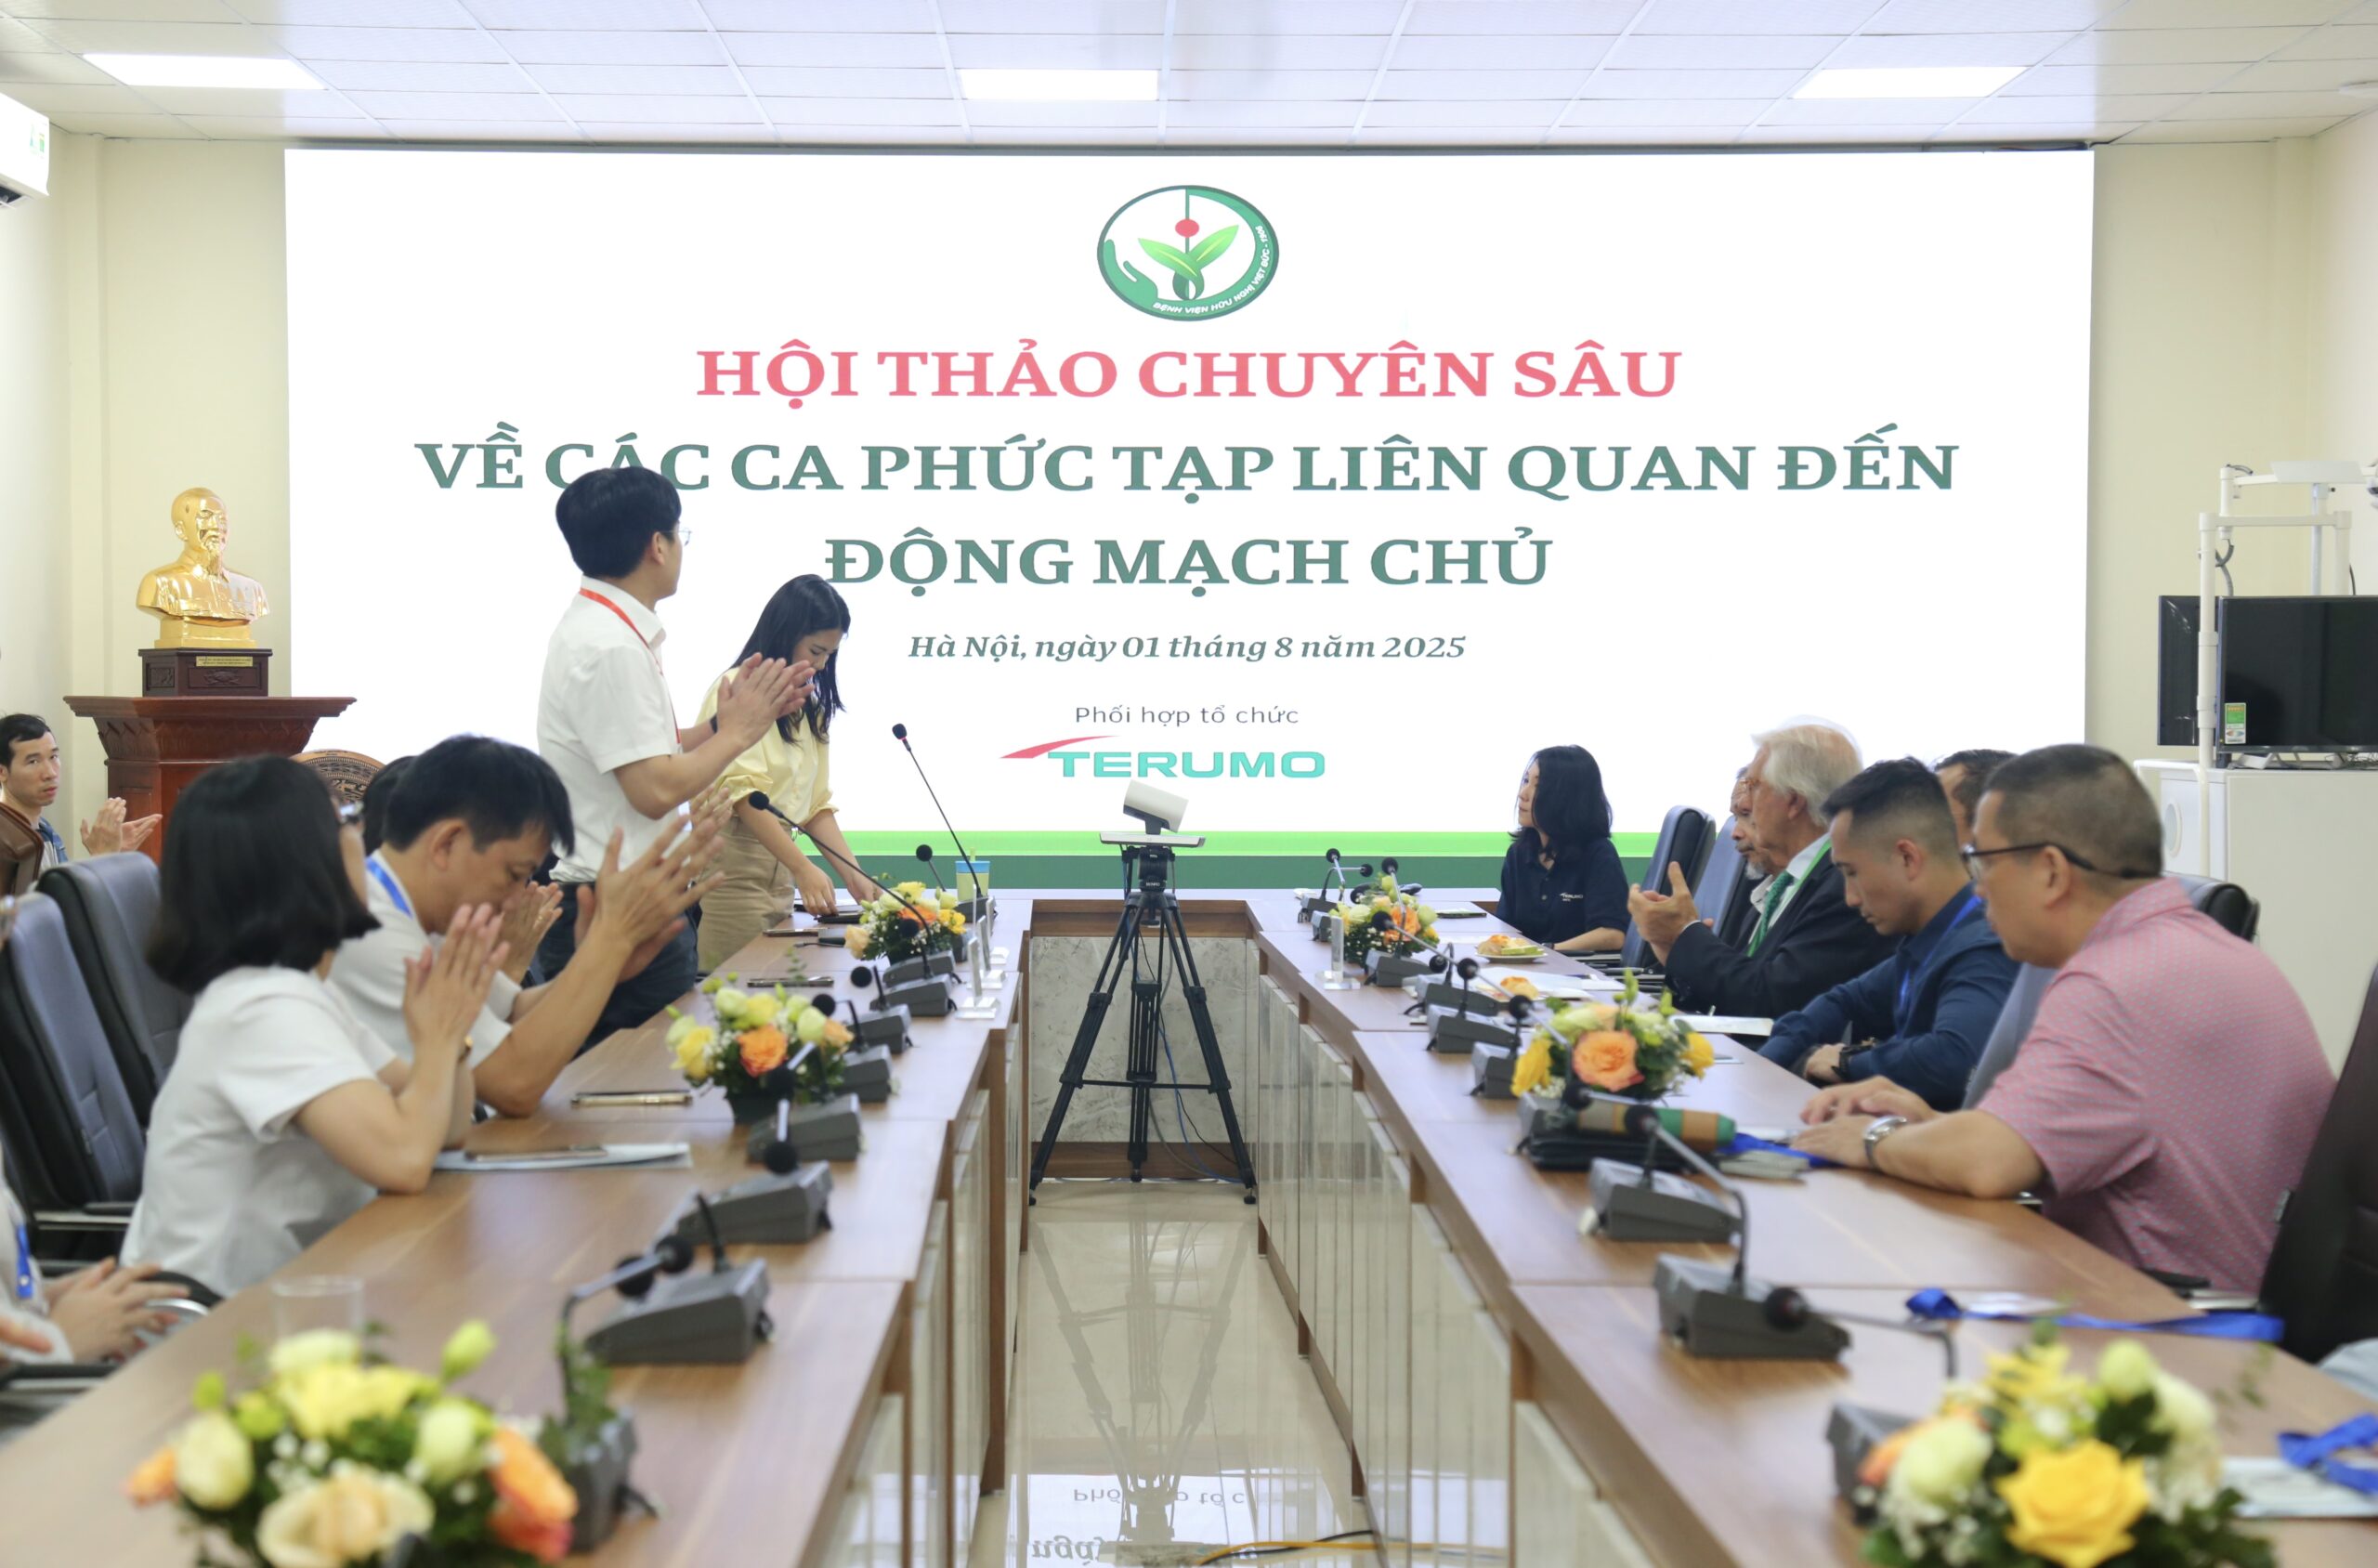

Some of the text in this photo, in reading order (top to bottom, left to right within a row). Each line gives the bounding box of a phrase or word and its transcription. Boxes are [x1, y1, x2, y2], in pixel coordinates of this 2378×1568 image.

[697, 338, 1682, 410] HỘI THẢO CHUYÊN SÂU
[414, 421, 523, 489] VỀ
[731, 444, 843, 490] CA
[861, 433, 1093, 491] PHỨC
[1112, 446, 1274, 504] TẠP
[1293, 433, 1488, 490] LIÊN
[1508, 445, 1757, 502] QUAN
[1777, 423, 1960, 490] ĐẾN
[825, 526, 1554, 597] ĐỘNG MẠCH CHỦ
[908, 634, 1467, 662] Hà Nội, ngày 01 tháng 8 năm 2025
[1075, 704, 1299, 727] Phối hợp tổ chức
[1047, 751, 1326, 778] TERUMO
